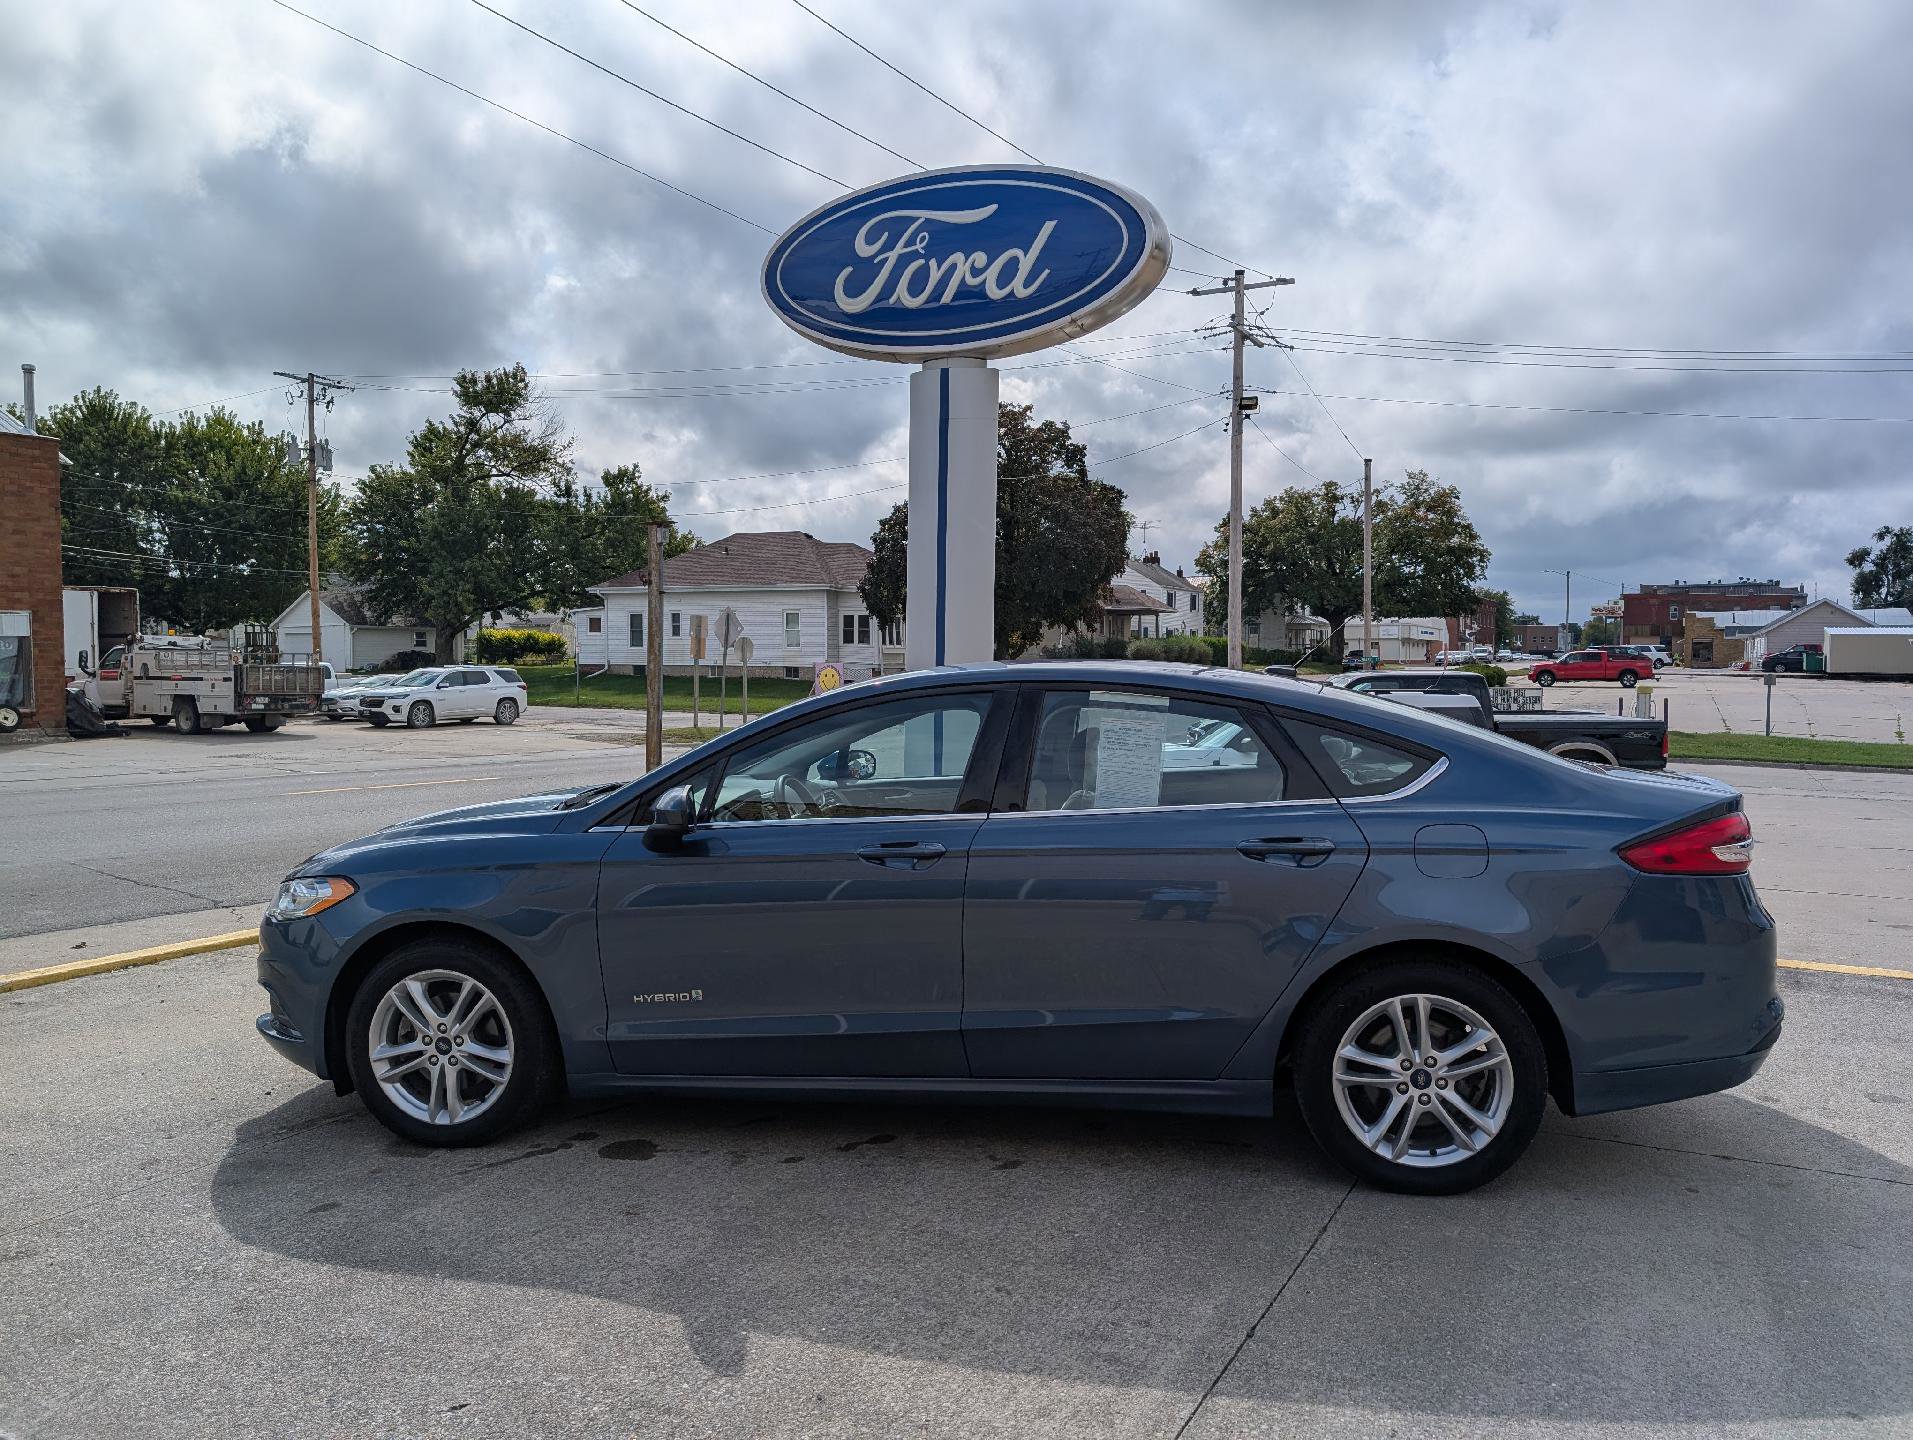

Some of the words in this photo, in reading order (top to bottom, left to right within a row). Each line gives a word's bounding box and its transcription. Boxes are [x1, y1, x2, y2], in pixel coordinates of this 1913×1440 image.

[834, 203, 1058, 314] Ford
[1514, 689, 1526, 697] POST
[634, 993, 690, 1003] HYBRID
